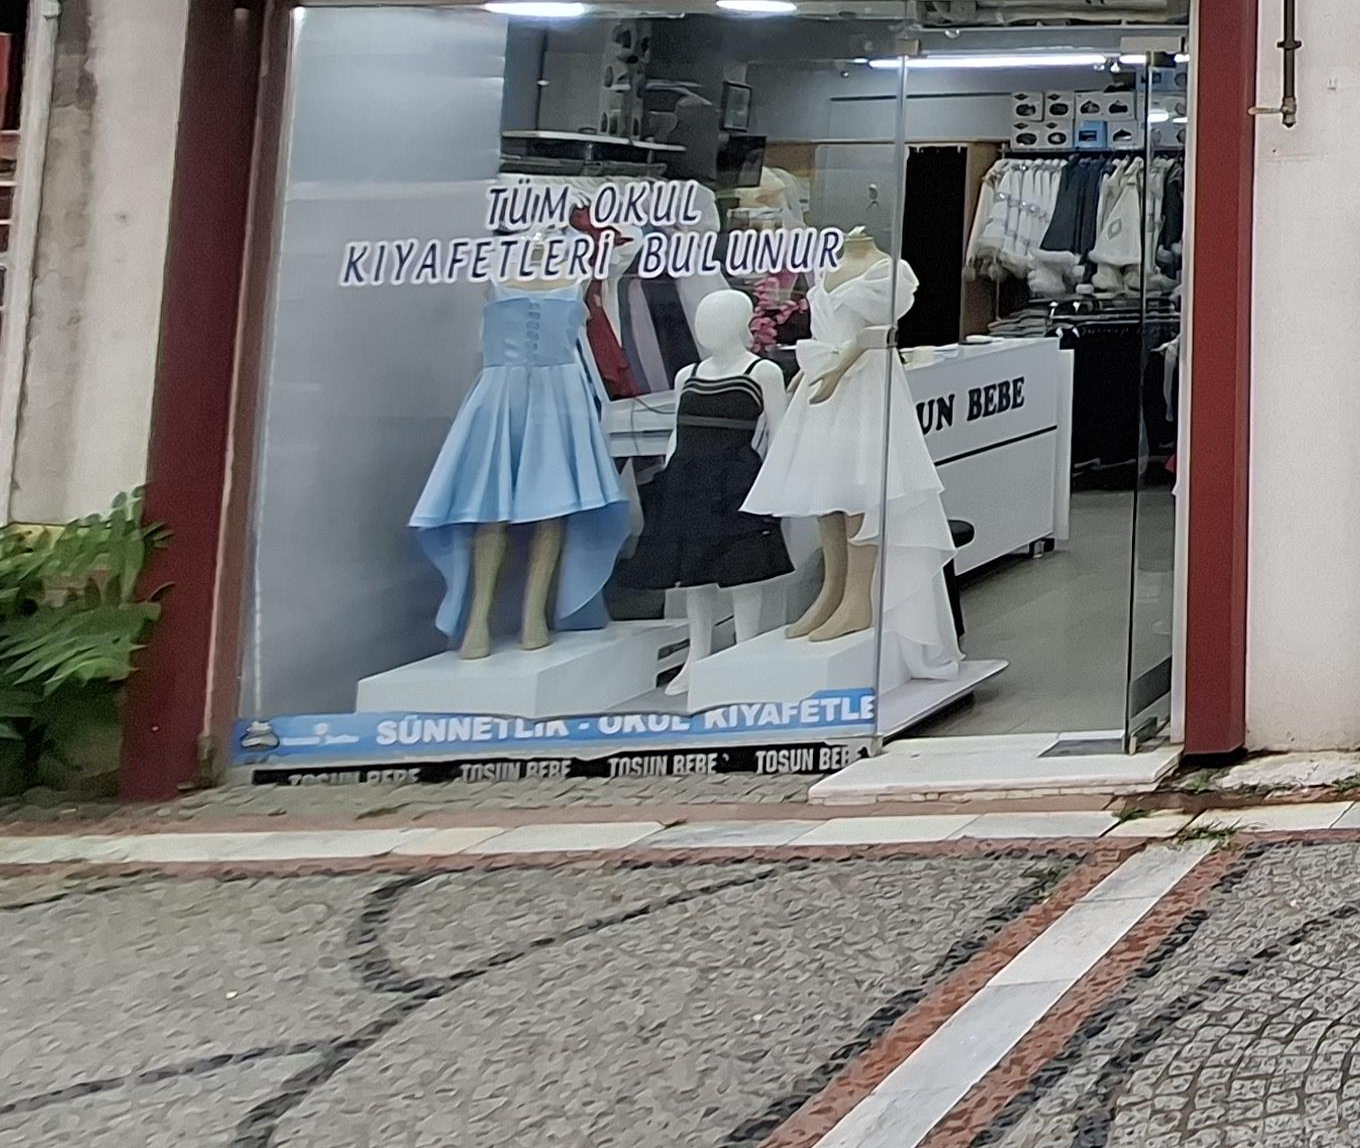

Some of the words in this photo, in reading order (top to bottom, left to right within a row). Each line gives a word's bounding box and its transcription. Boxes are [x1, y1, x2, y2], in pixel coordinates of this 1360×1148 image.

[488, 177, 572, 228] TÜM
[594, 181, 702, 226] OKUL
[342, 231, 615, 285] KIYAFETLERİ
[641, 229, 843, 276] BULUNUR
[966, 375, 1025, 422] BEBE
[755, 748, 815, 773] TOSUN
